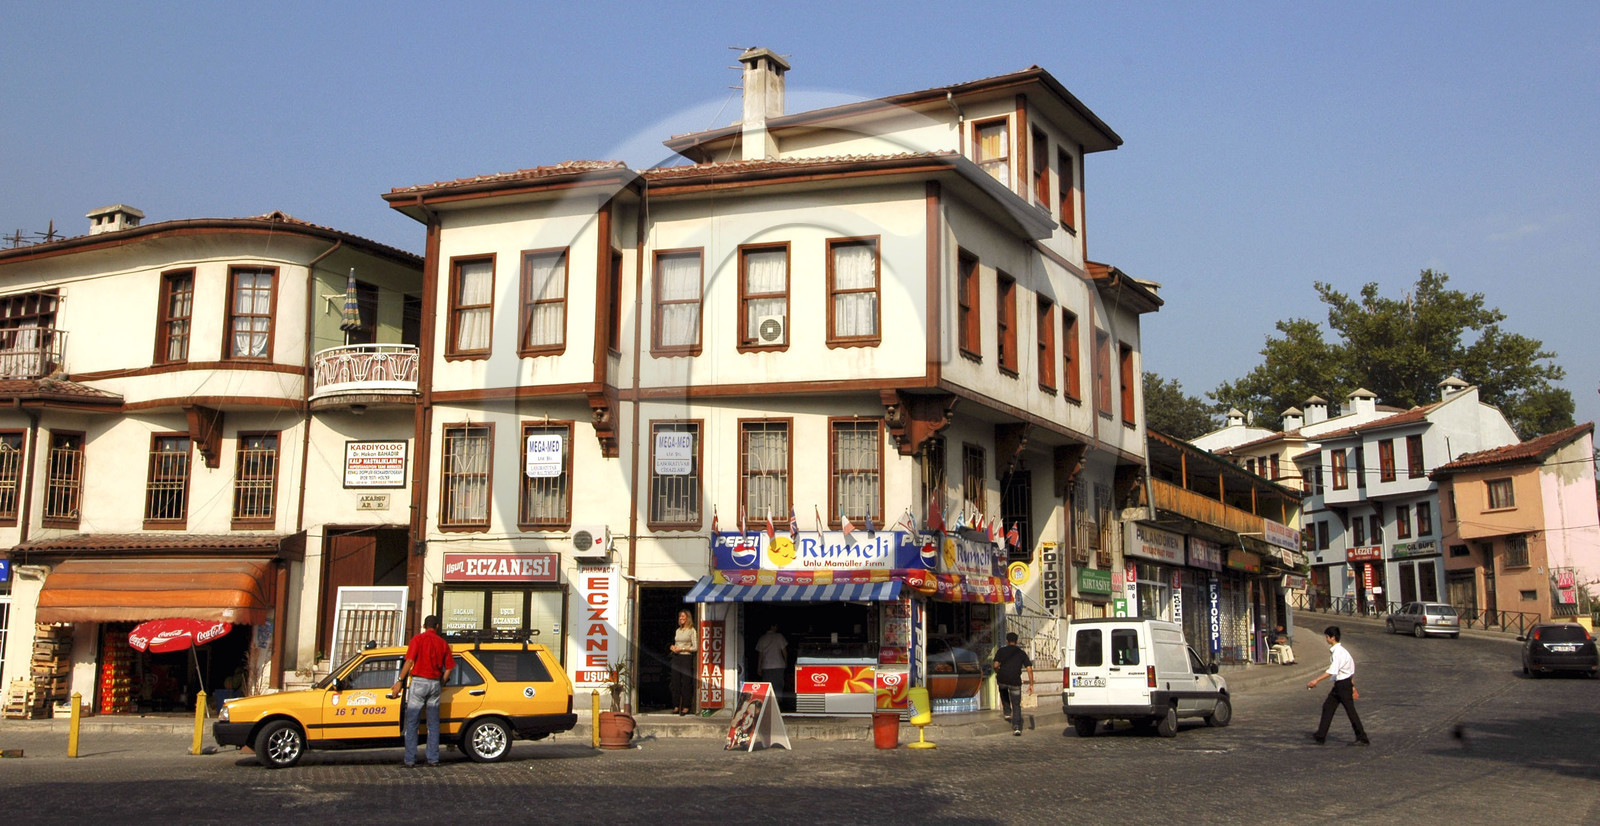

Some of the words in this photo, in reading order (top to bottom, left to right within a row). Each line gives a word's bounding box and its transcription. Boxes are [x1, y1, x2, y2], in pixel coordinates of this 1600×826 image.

[350, 443, 403, 451] KARDİYOLOG
[529, 440, 560, 452] MEGA-MED
[659, 436, 690, 448] MEGA-MED
[715, 536, 760, 548] PEPSI
[801, 536, 889, 559] Rumeli
[956, 542, 991, 566] Rumeli
[465, 556, 551, 576] ECZANESİ
[824, 559, 862, 567] Mamüller
[585, 577, 609, 667] ECZANE
[701, 626, 710, 702] ECZANE
[711, 626, 722, 702] ECZANE
[336, 708, 346, 716] 16
[351, 707, 357, 716] T
[362, 706, 387, 715] 0092
